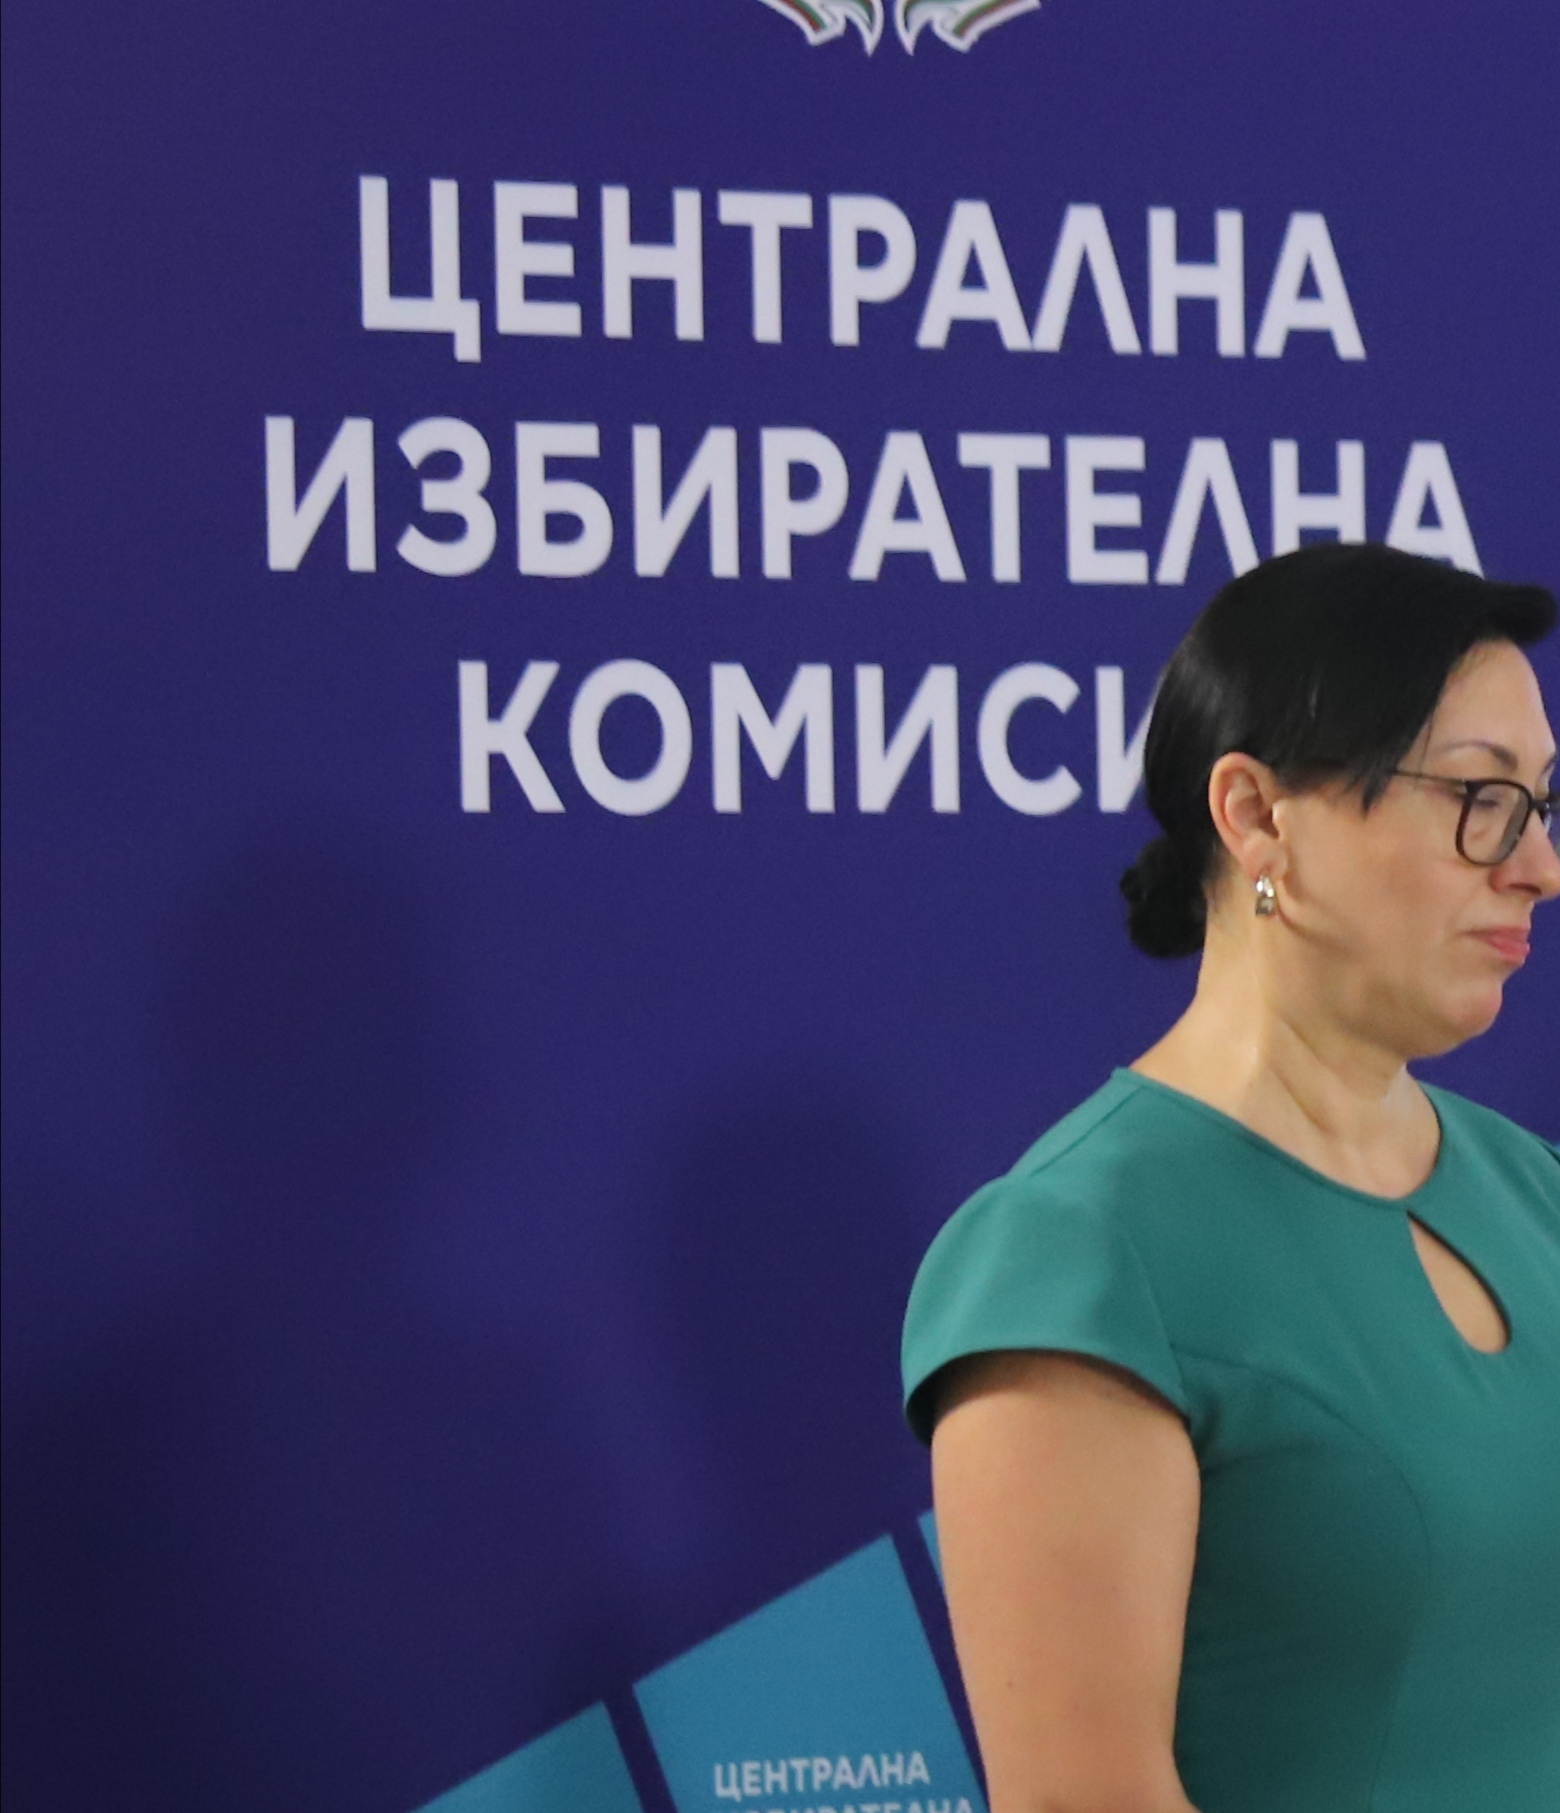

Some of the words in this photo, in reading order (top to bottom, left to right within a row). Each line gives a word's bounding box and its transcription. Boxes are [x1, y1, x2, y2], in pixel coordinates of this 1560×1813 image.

[358, 174, 1367, 361] ЦЕНТРАЛНА
[264, 415, 1482, 586] ИЗБИРАТЕЛНА
[714, 1750, 930, 1802] ЦЕНТРАЛНА
